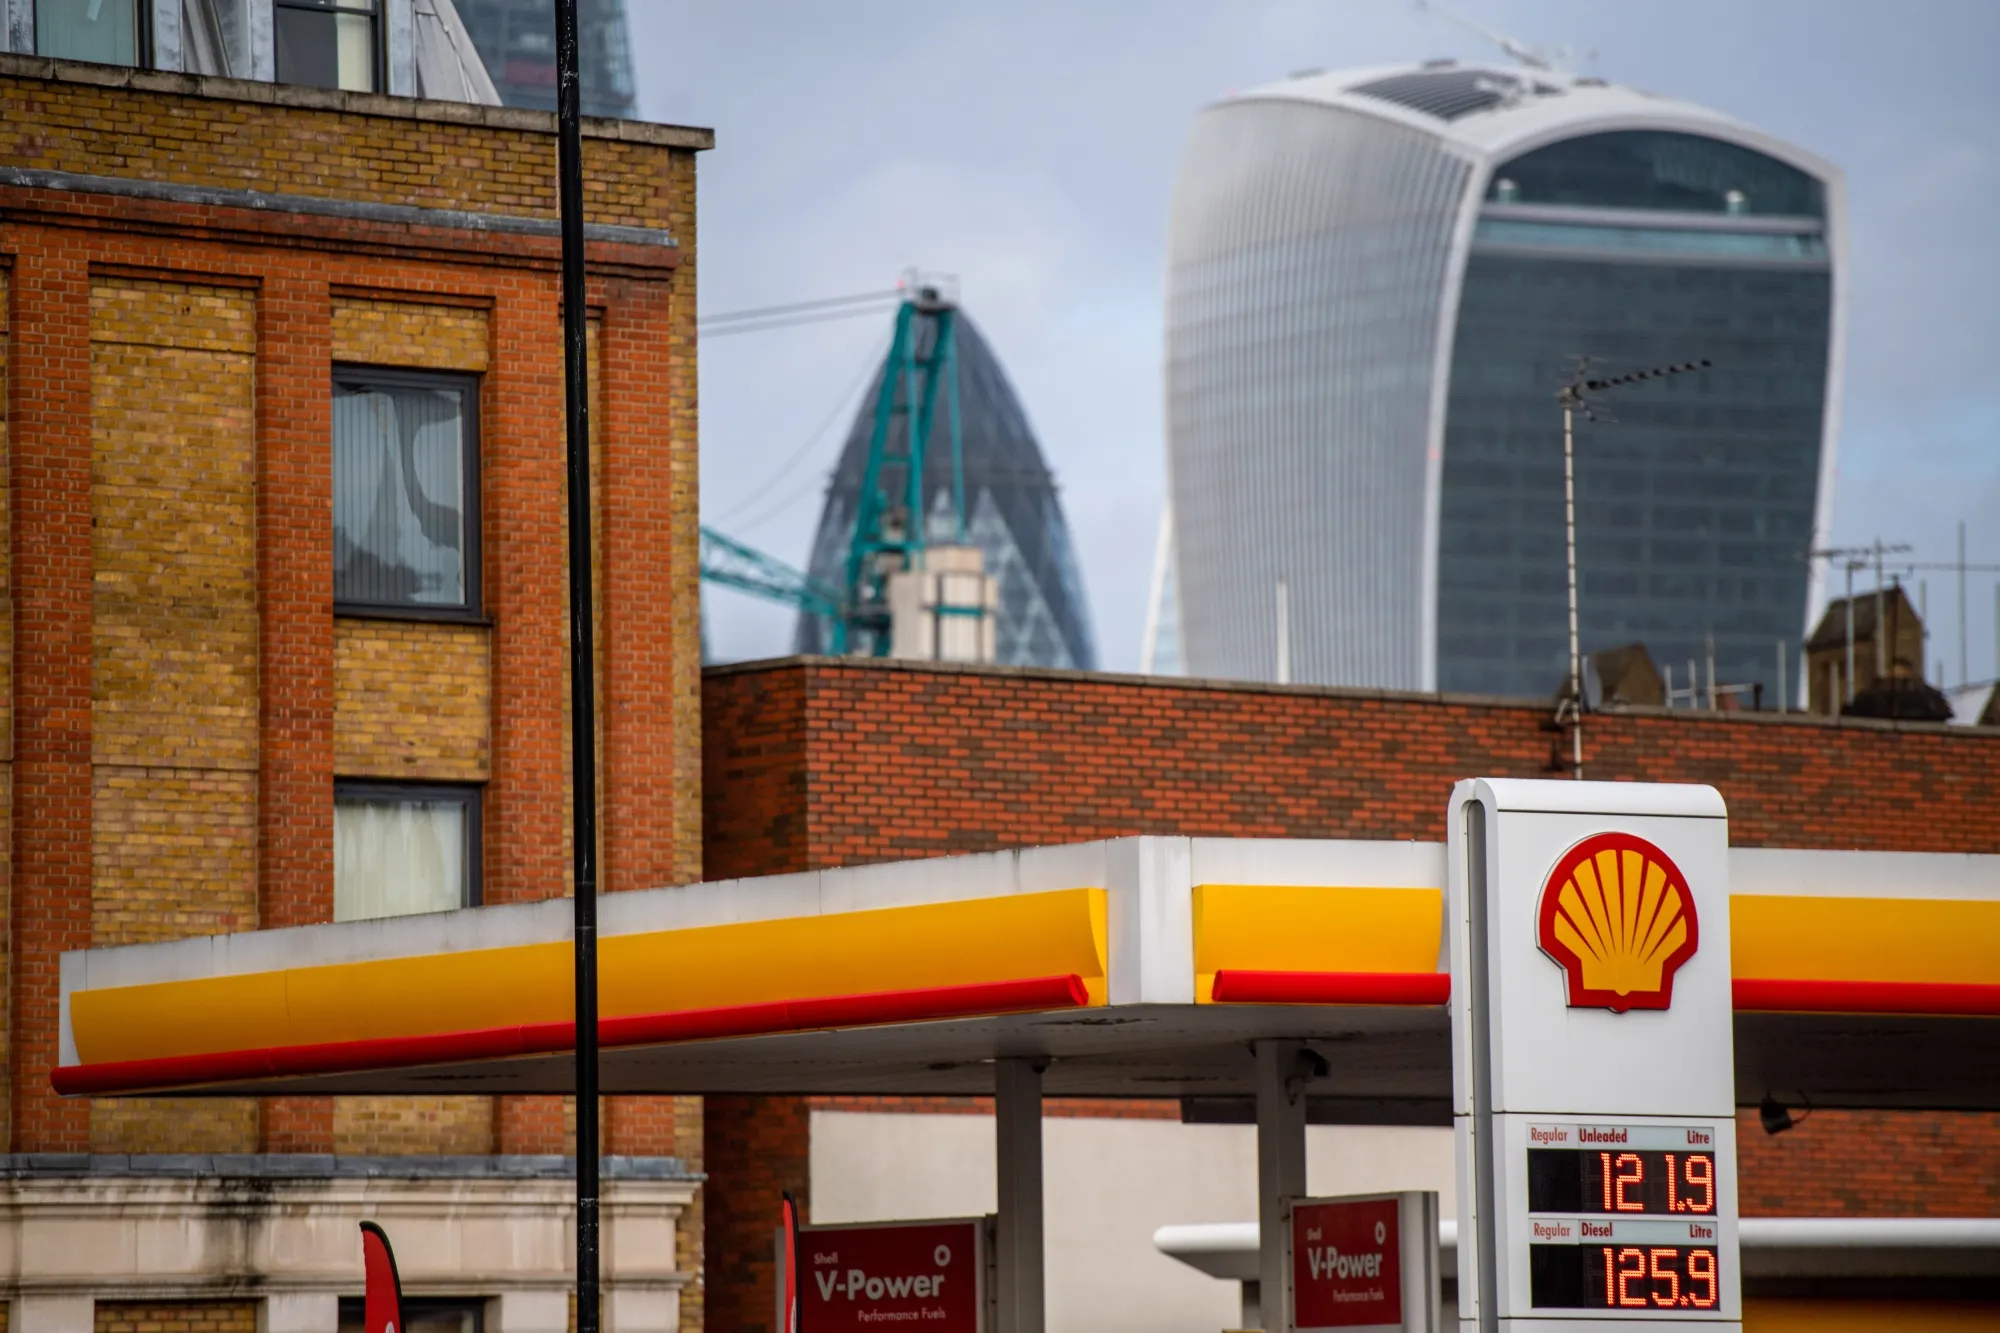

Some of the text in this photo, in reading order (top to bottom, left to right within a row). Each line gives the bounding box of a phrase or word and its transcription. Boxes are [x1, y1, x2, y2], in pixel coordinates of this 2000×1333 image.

[1531, 1127, 1710, 1145] Regular Unleaded Litre
[1533, 1222, 1713, 1240] Regular Diesel Litre
[814, 1252, 839, 1265] Shell
[1307, 1246, 1383, 1281] V-Power
[814, 1268, 945, 1302] V-Power
[1603, 1248, 1716, 1307] 125.9
[858, 1306, 946, 1322] Performance Fuels
